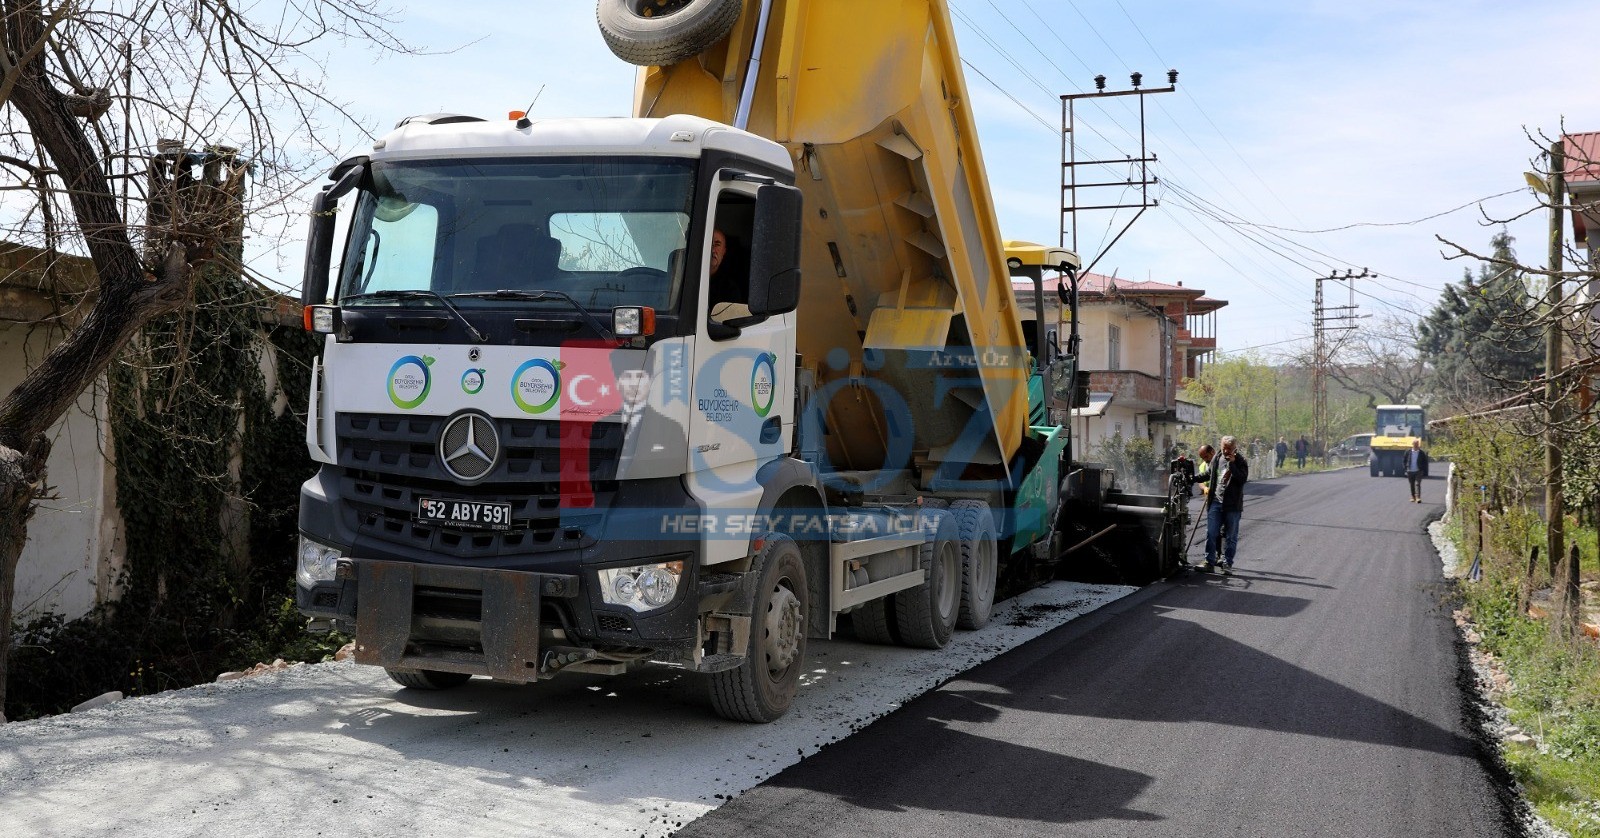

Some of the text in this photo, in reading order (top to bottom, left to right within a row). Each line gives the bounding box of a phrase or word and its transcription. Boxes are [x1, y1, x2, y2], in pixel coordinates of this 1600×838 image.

[713, 388, 728, 398] ORDU
[427, 500, 509, 524] 52 ABY 591
